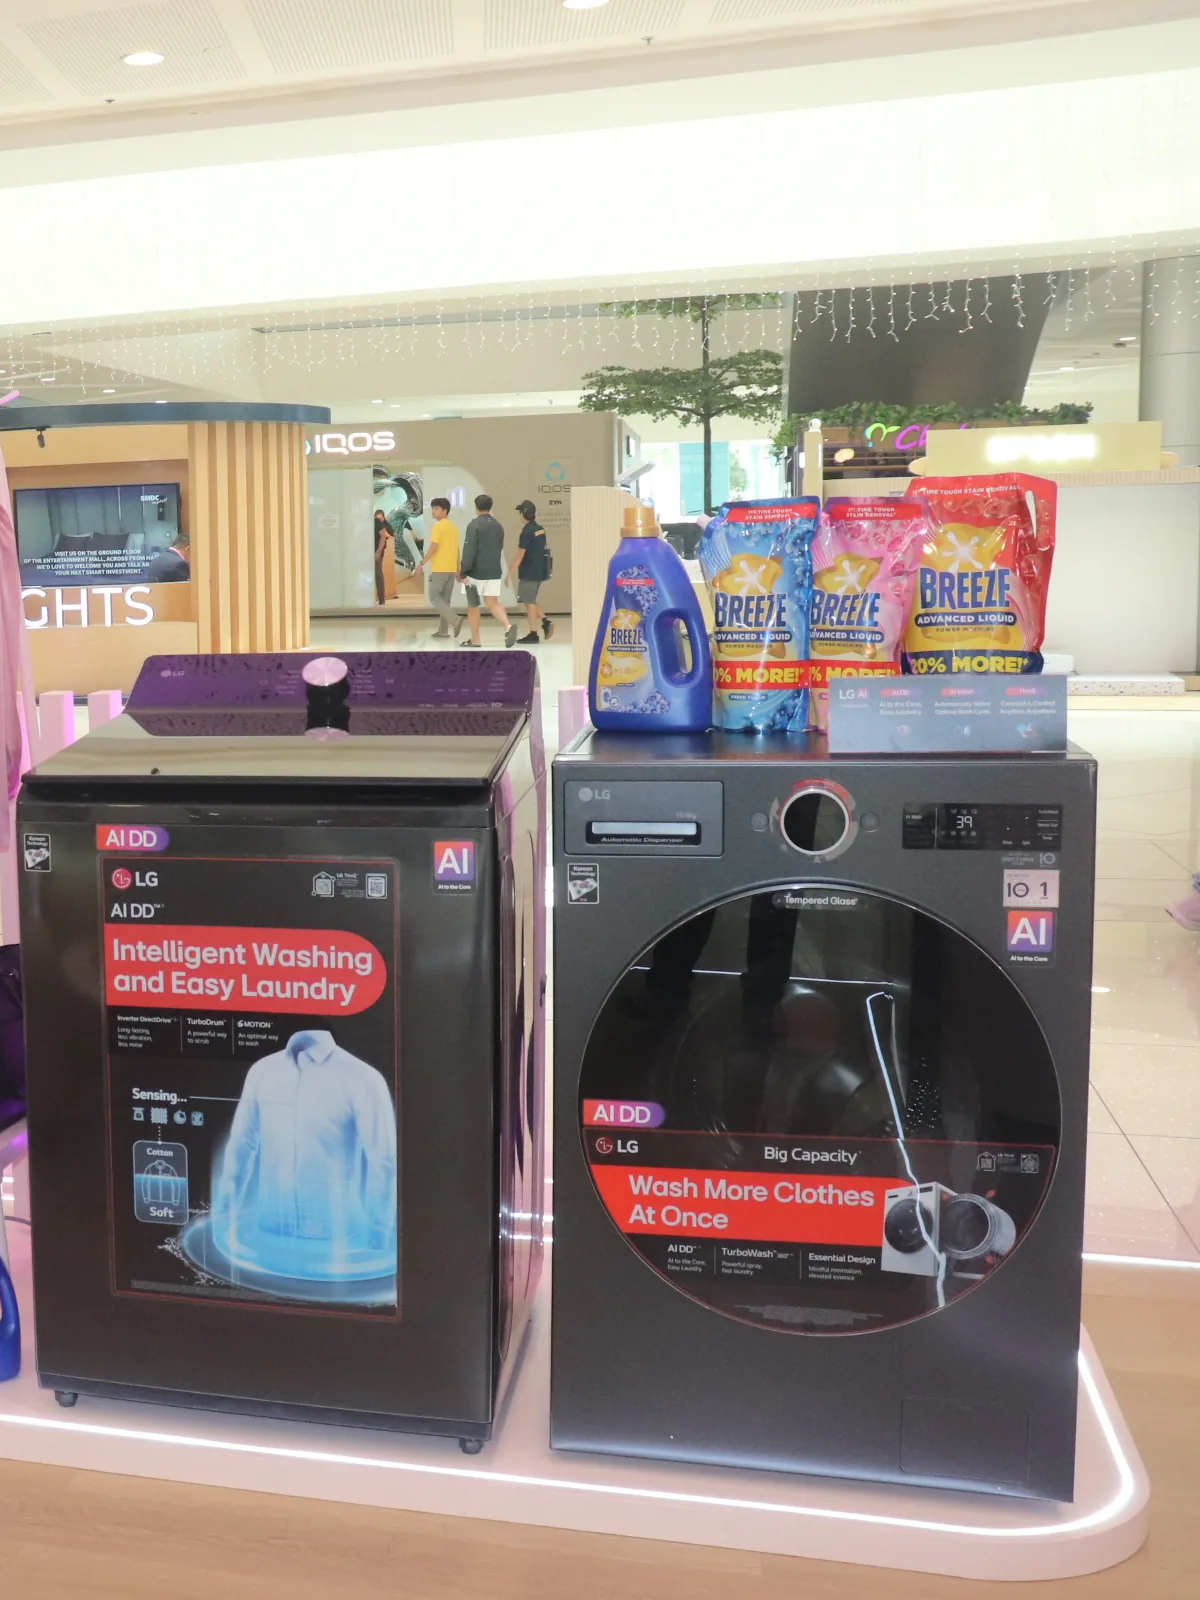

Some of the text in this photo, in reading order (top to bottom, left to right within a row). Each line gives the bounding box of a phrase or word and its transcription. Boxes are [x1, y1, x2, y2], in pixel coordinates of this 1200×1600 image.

[315, 431, 396, 455] IQOS
[538, 484, 572, 494] IQOS
[919, 567, 1010, 610] BREEZE
[714, 592, 787, 628] BREEZE
[811, 589, 881, 628] BREEZE
[917, 614, 1014, 624] ADVANCED LIQUID
[610, 628, 643, 645] BREEZE
[849, 632, 882, 641] LIQUID
[839, 689, 868, 700] LG AI
[595, 789, 611, 800] LG
[957, 816, 972, 828] 39
[105, 829, 157, 847] AI DD
[437, 847, 469, 875] AI
[136, 871, 158, 887] LG
[1007, 881, 1048, 898] 10 1
[784, 893, 836, 907] Tempered
[110, 903, 127, 918] AI
[1010, 917, 1047, 946] AI
[113, 938, 373, 976] Intelligent Washing
[114, 971, 356, 1007] and Easy Laundry
[117, 1027, 151, 1036] Long-lasting,
[193, 1030, 216, 1039] powerful
[216, 1032, 227, 1040] way
[248, 1033, 267, 1041] optimal
[267, 1034, 279, 1042] way
[593, 1104, 651, 1123] AI DD
[146, 1147, 174, 1157] Cotton
[617, 1139, 639, 1153] LG
[764, 1146, 858, 1166] Big Capacity
[628, 1174, 875, 1208] Wash More Clothes
[149, 1206, 174, 1219] Soft
[629, 1204, 729, 1230] At Once
[667, 1244, 677, 1253] AI
[808, 1252, 876, 1266] Essential Design
